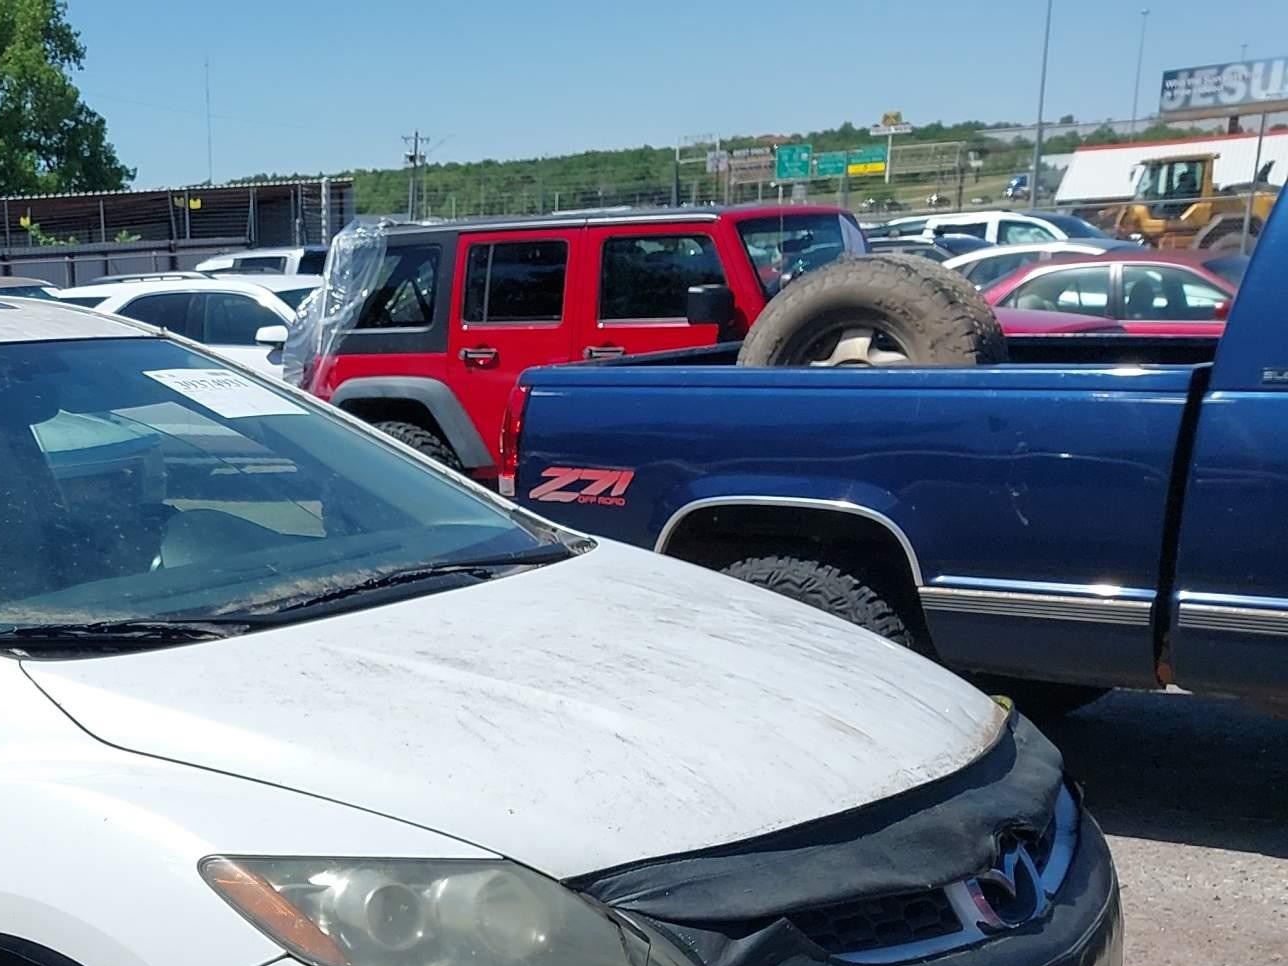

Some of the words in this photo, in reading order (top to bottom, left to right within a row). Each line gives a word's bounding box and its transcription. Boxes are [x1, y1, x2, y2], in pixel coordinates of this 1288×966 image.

[1161, 60, 1288, 110] JESU
[529, 466, 635, 503] Z71
[578, 496, 597, 504] OFF
[598, 496, 626, 507] ROAD
